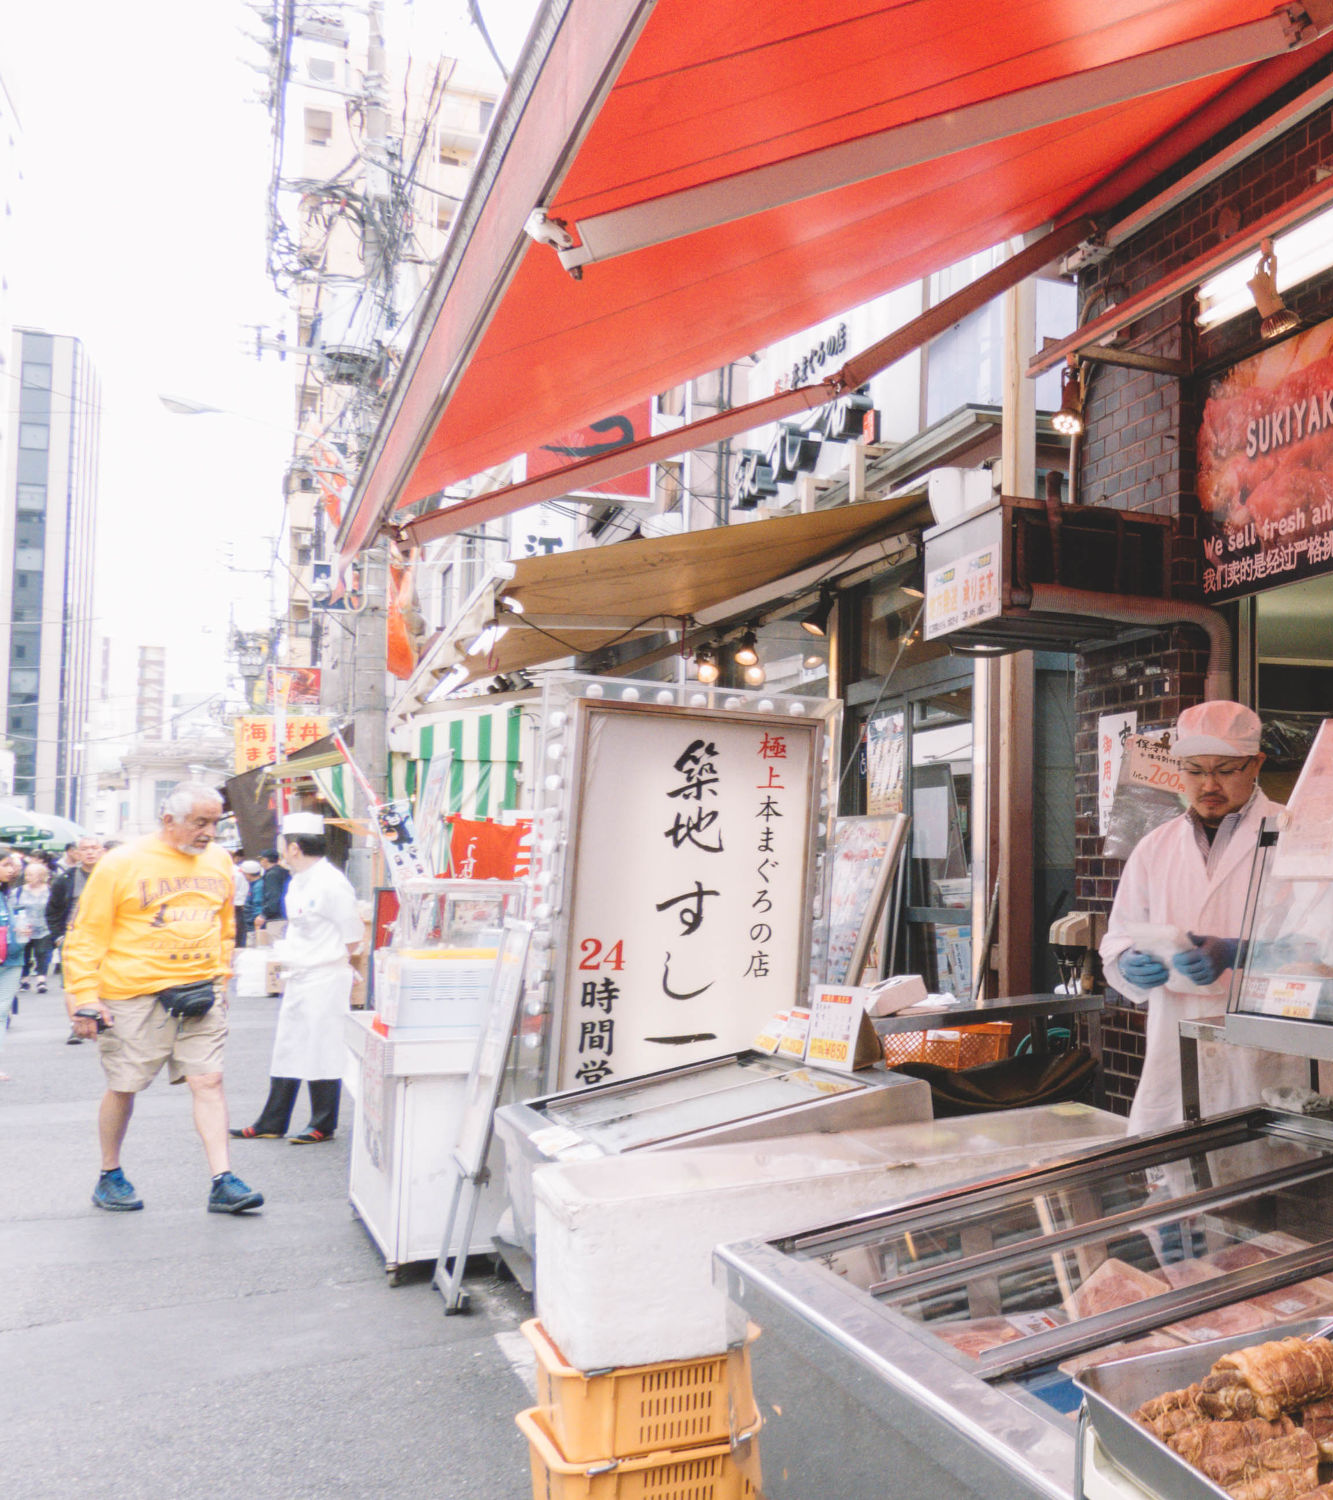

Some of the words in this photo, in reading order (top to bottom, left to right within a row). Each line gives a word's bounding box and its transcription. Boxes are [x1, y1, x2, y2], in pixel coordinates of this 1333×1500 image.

[1203, 535, 1223, 560] We
[1228, 522, 1256, 552] sell
[1263, 503, 1306, 542] fresh
[743, 732, 787, 978] 極上本まぐろの店
